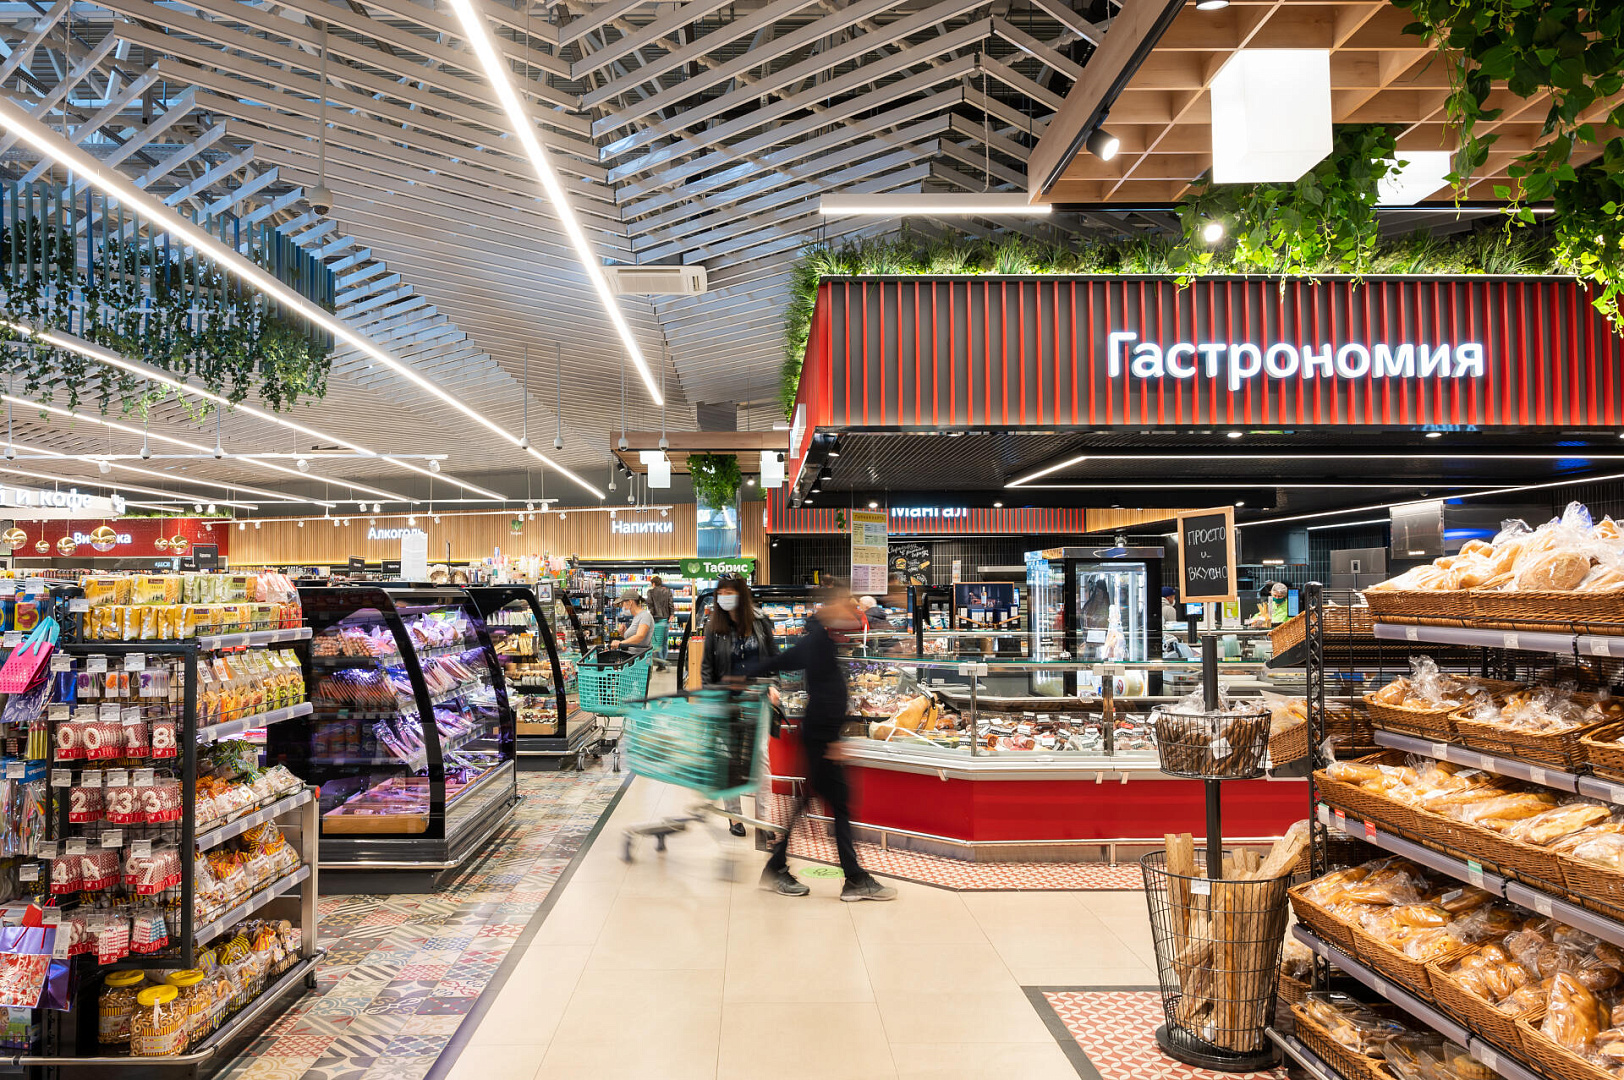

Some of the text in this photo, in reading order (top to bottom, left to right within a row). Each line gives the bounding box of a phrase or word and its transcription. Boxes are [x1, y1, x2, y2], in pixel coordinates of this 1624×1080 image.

[1108, 332, 1483, 391] Гастрономия
[40, 488, 93, 512] кофе
[611, 520, 674, 534] Напитки
[1188, 527, 1225, 546] ПРОСТО
[703, 561, 748, 574] Табрис
[1188, 565, 1228, 582] ВКУСНО
[153, 728, 170, 748] 8
[71, 791, 86, 812] 2
[116, 792, 132, 814] 3
[142, 790, 161, 813] 3
[52, 862, 68, 883] 4
[81, 858, 100, 880] 4
[139, 862, 155, 885] 7
